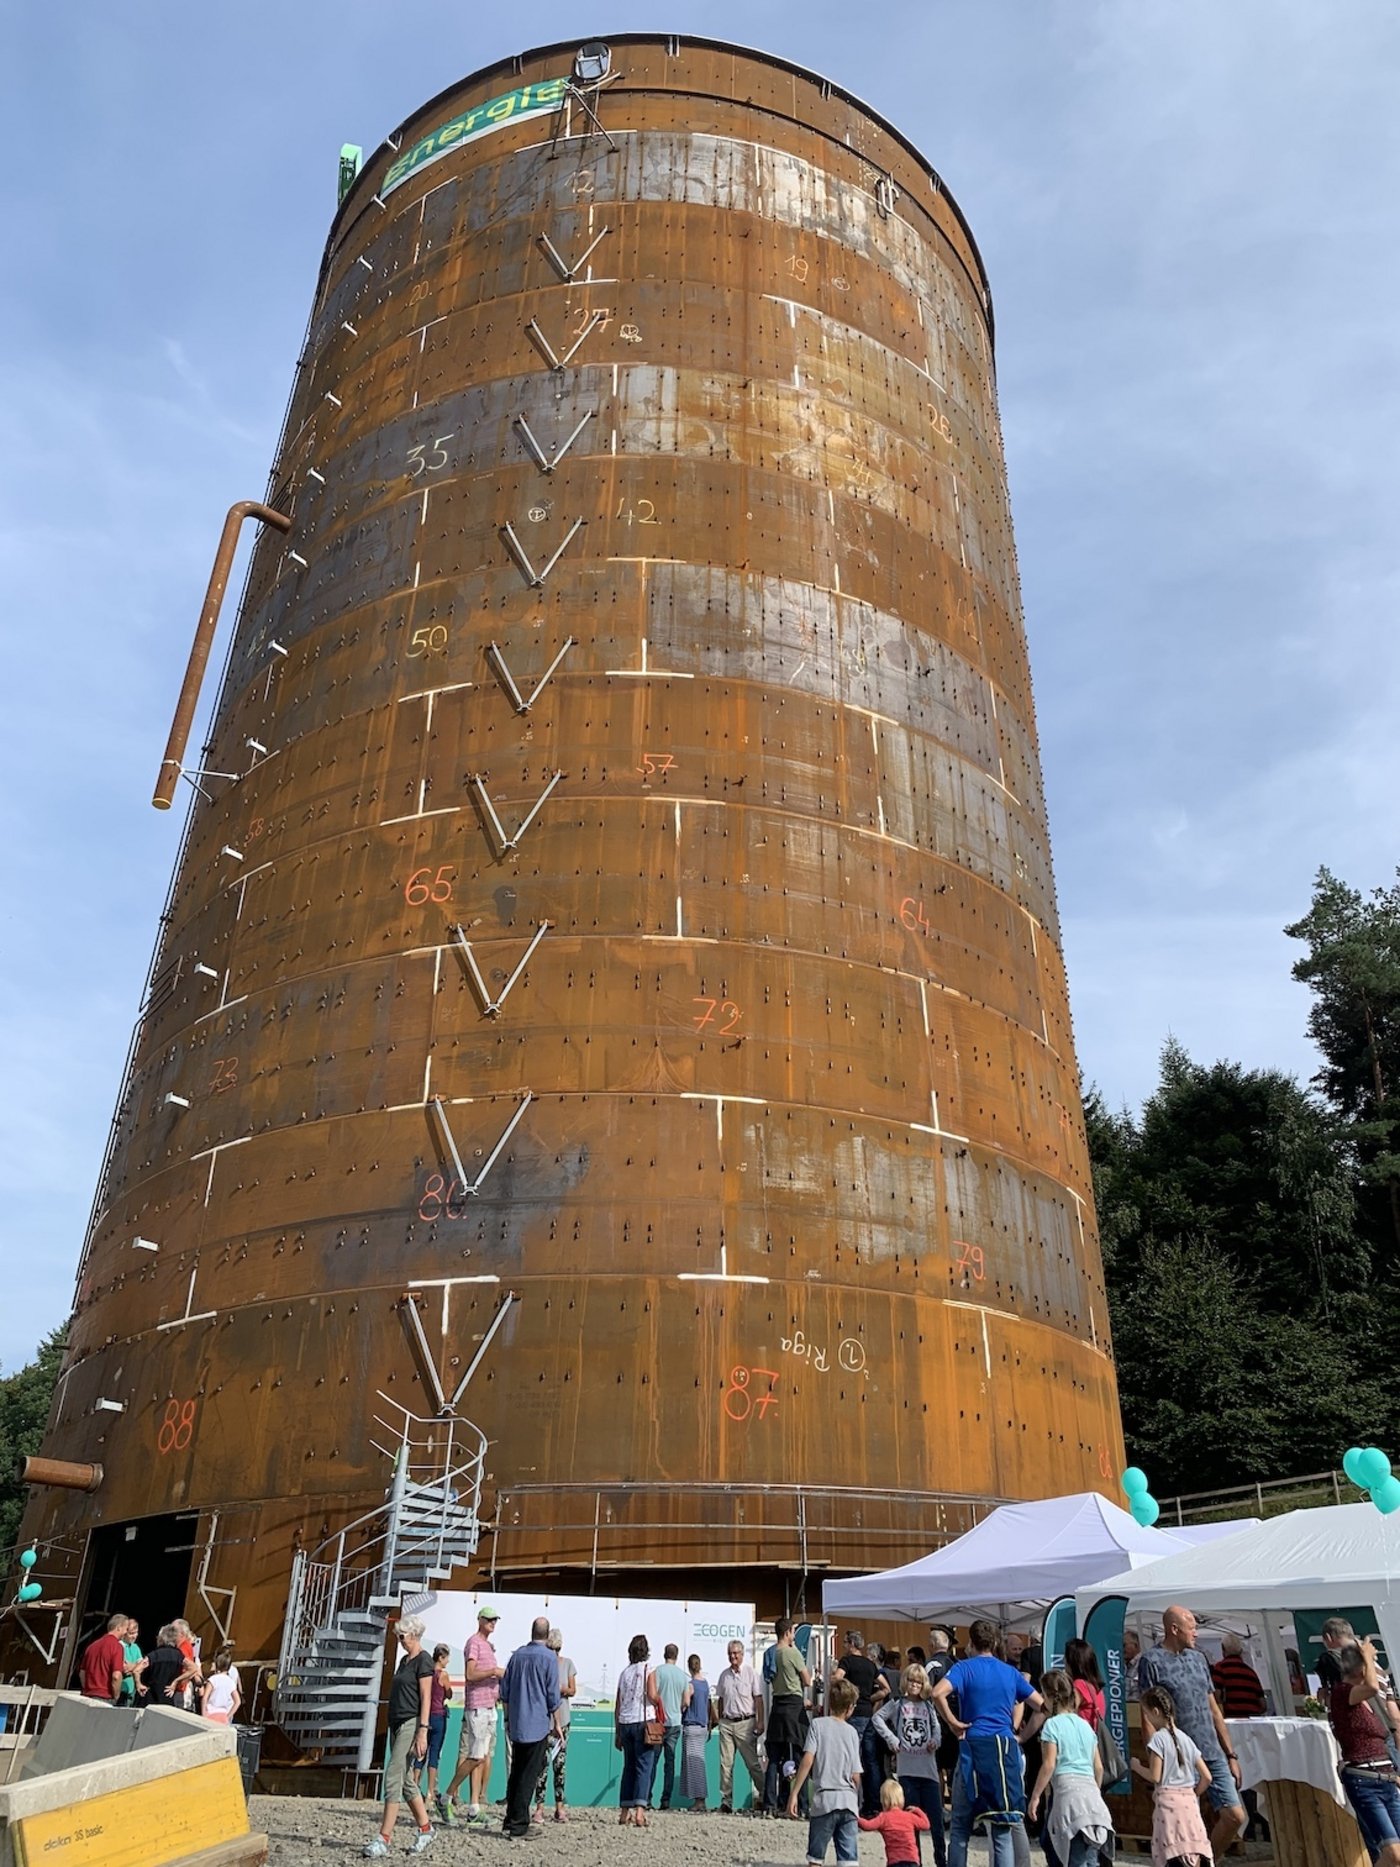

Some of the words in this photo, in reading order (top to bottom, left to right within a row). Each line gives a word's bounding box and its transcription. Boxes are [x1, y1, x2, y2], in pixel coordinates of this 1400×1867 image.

[784, 255, 809, 281] 19
[572, 308, 614, 333] 27
[406, 433, 455, 477] 35
[405, 625, 448, 658] 50
[636, 753, 679, 774] 57
[781, 1331, 831, 1372] Riga
[158, 1399, 195, 1454] 88
